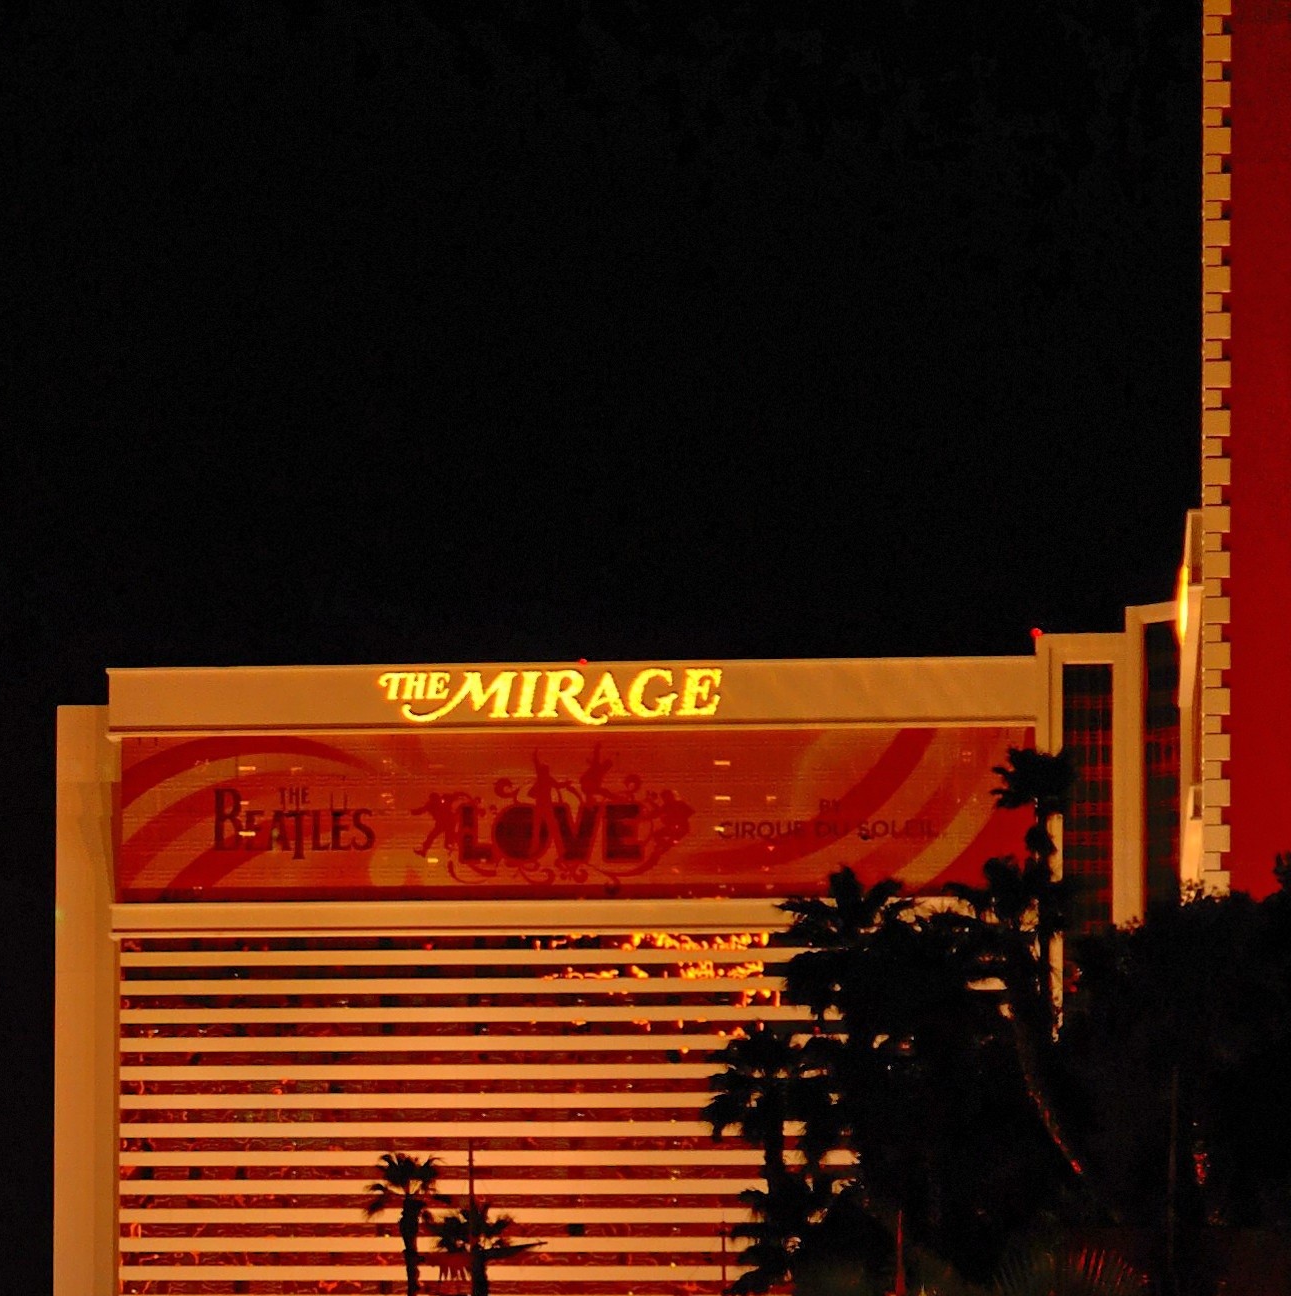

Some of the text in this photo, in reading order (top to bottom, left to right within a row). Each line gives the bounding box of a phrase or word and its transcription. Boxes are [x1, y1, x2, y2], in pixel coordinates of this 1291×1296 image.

[378, 669, 723, 726] THE MIRAGE
[279, 786, 309, 806] THE
[213, 787, 643, 864] BEATLES LOVE
[717, 819, 805, 840] CIRQUE
